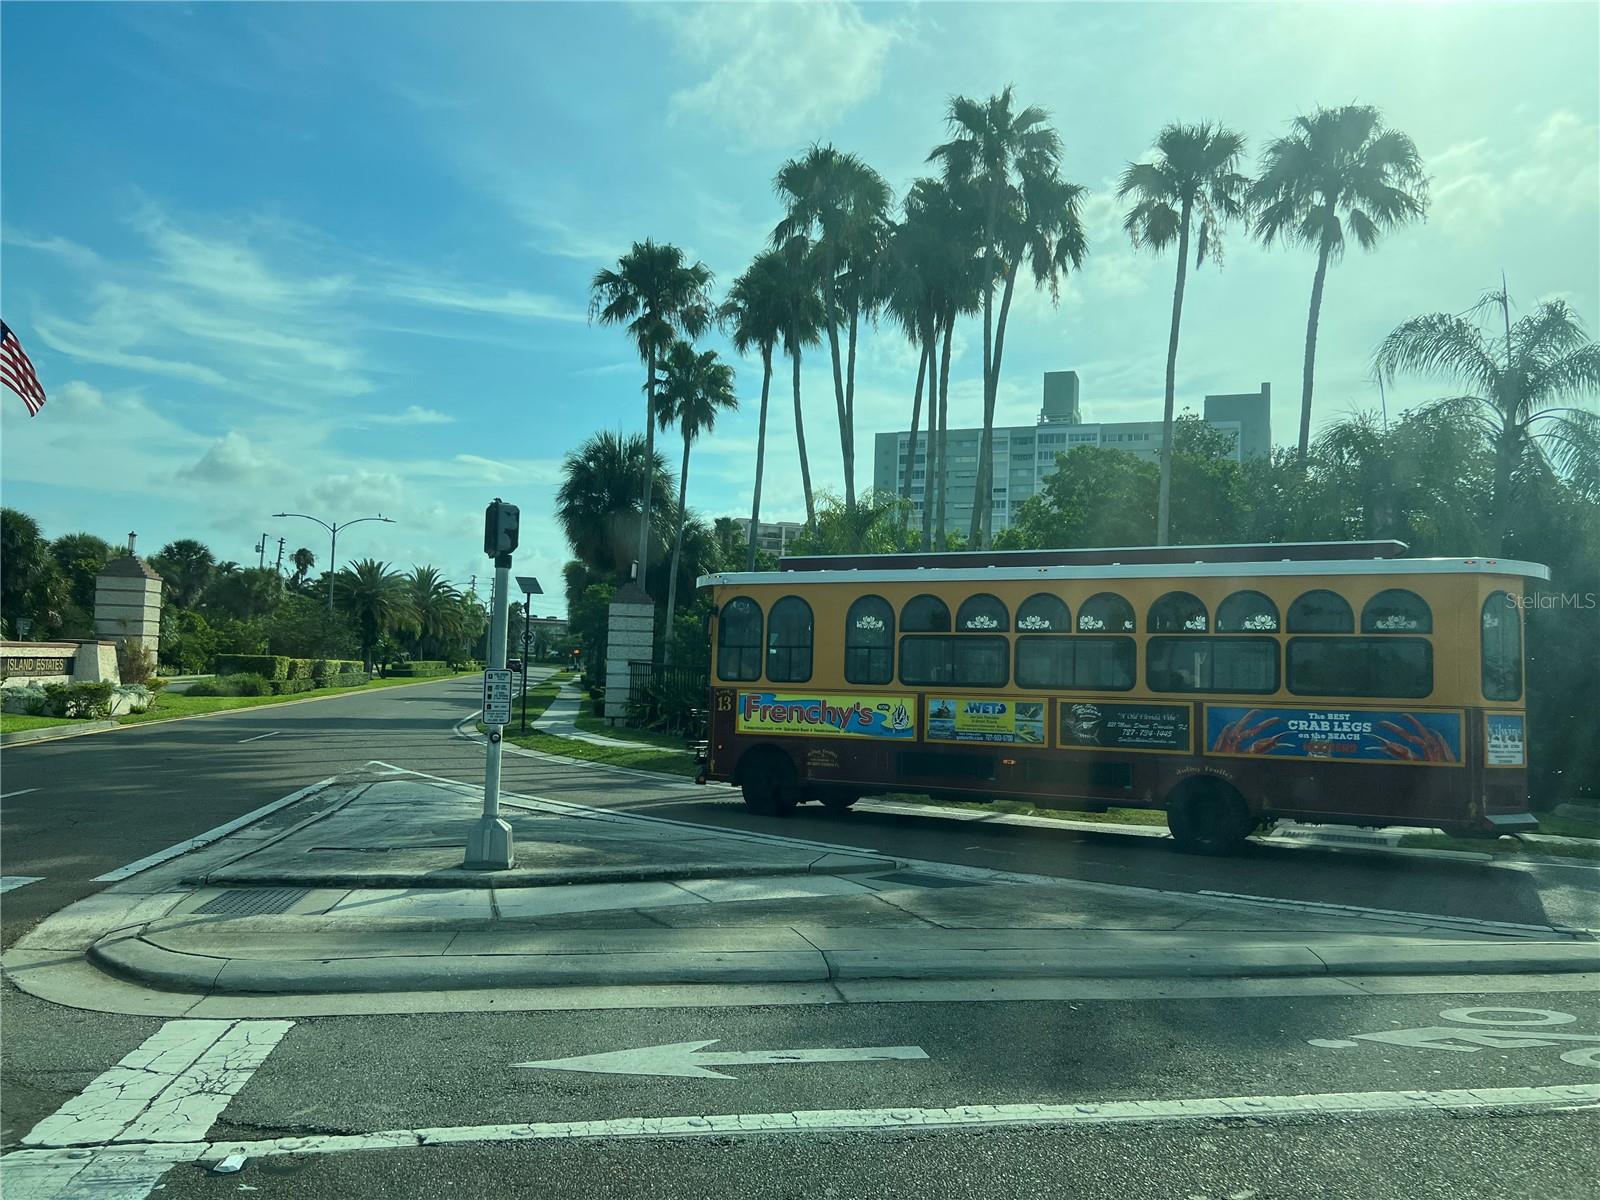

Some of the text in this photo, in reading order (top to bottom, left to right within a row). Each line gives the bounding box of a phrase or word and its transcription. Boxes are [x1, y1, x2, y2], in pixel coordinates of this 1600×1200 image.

[7, 658, 64, 671] ISLAND ESTATES
[718, 696, 732, 711] 13
[744, 694, 874, 729] Frenchy's
[1327, 713, 1351, 721] BEST
[1288, 720, 1372, 732] CRAB LEGS
[1327, 732, 1361, 741] BEACH
